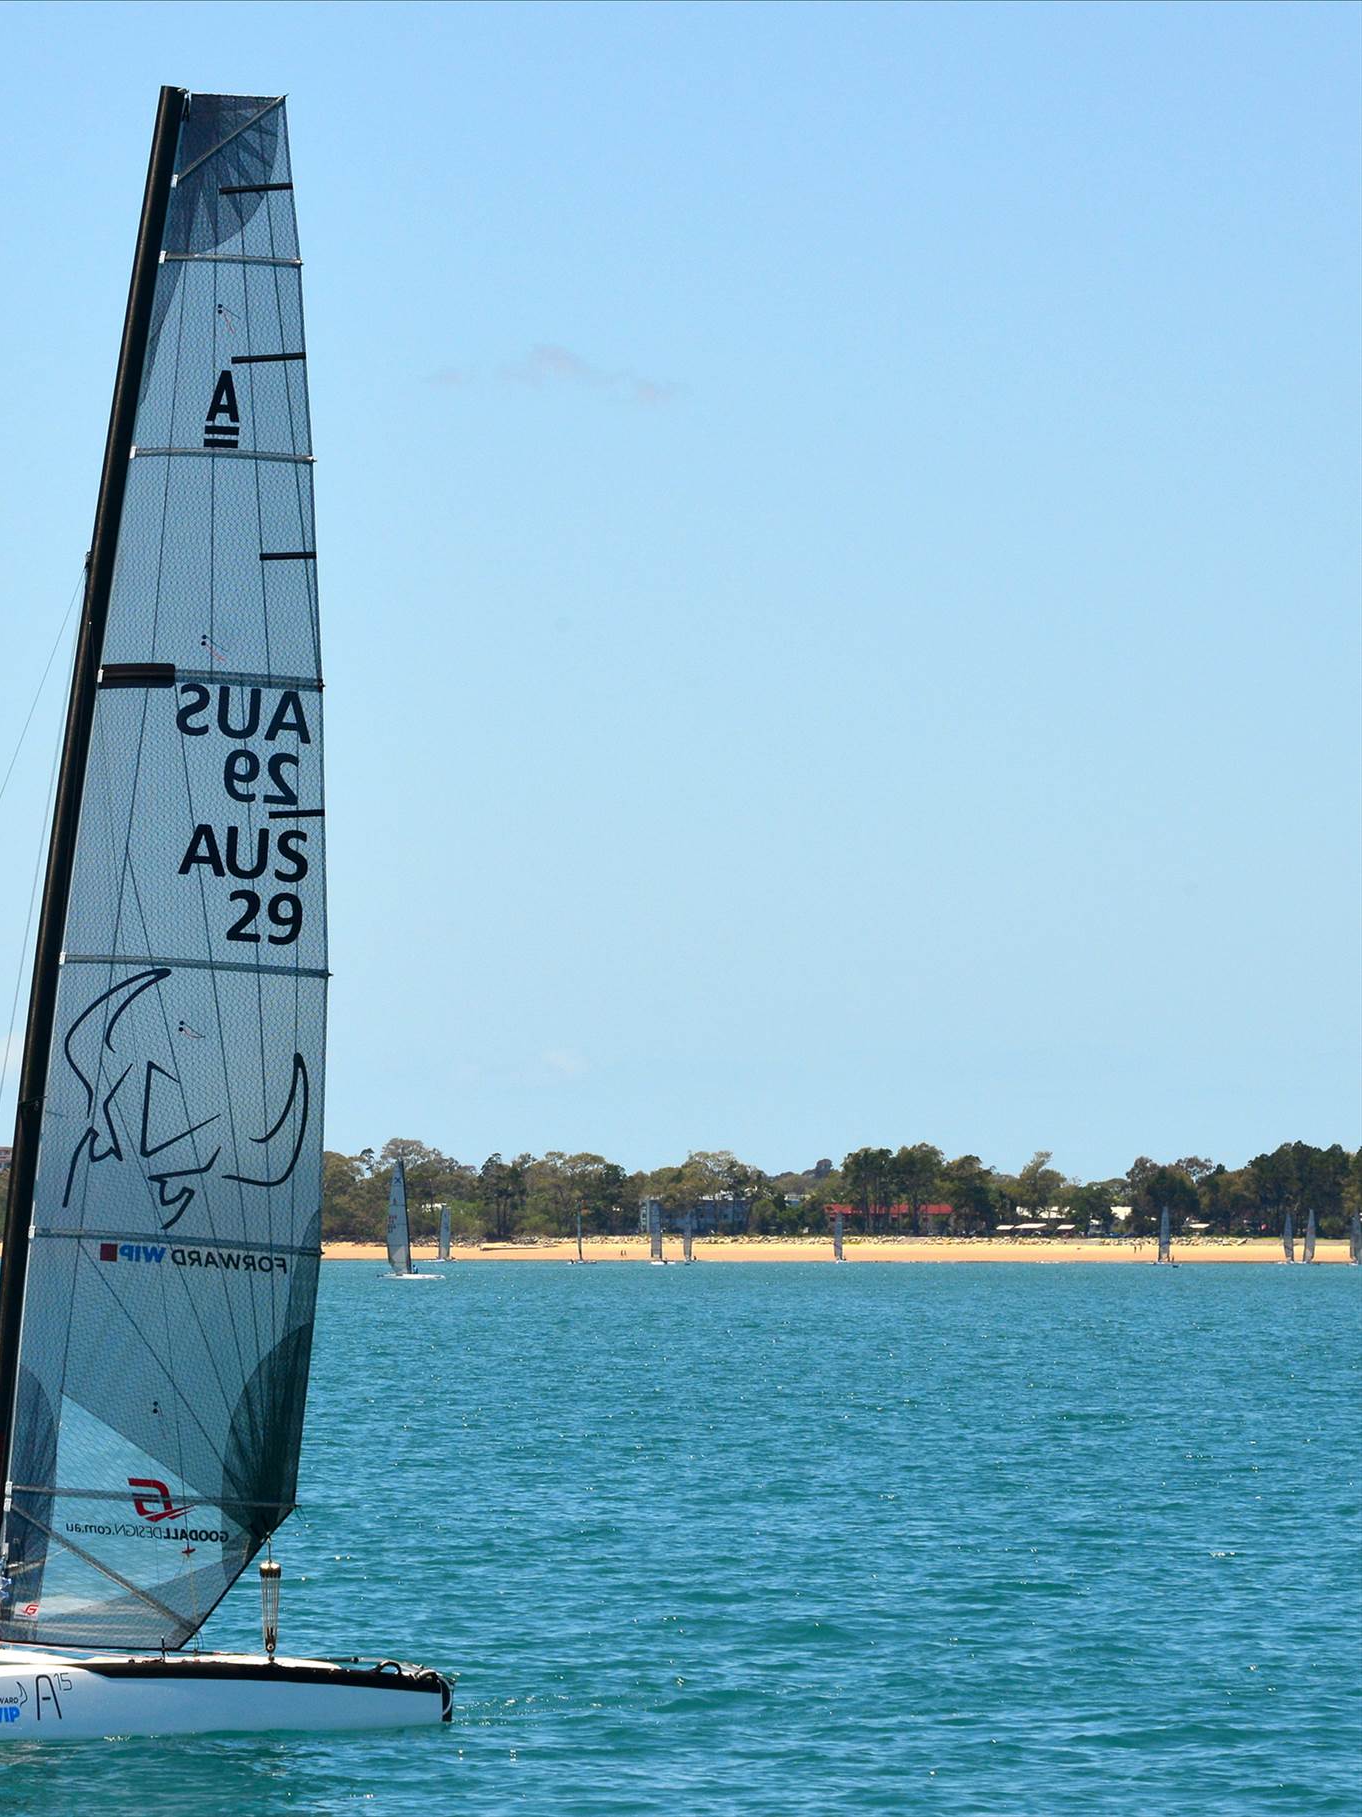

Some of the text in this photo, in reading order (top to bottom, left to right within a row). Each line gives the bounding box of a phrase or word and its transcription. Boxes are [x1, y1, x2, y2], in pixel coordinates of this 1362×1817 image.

[206, 369, 240, 423] A
[178, 824, 309, 883] AUS
[226, 889, 303, 945] 29
